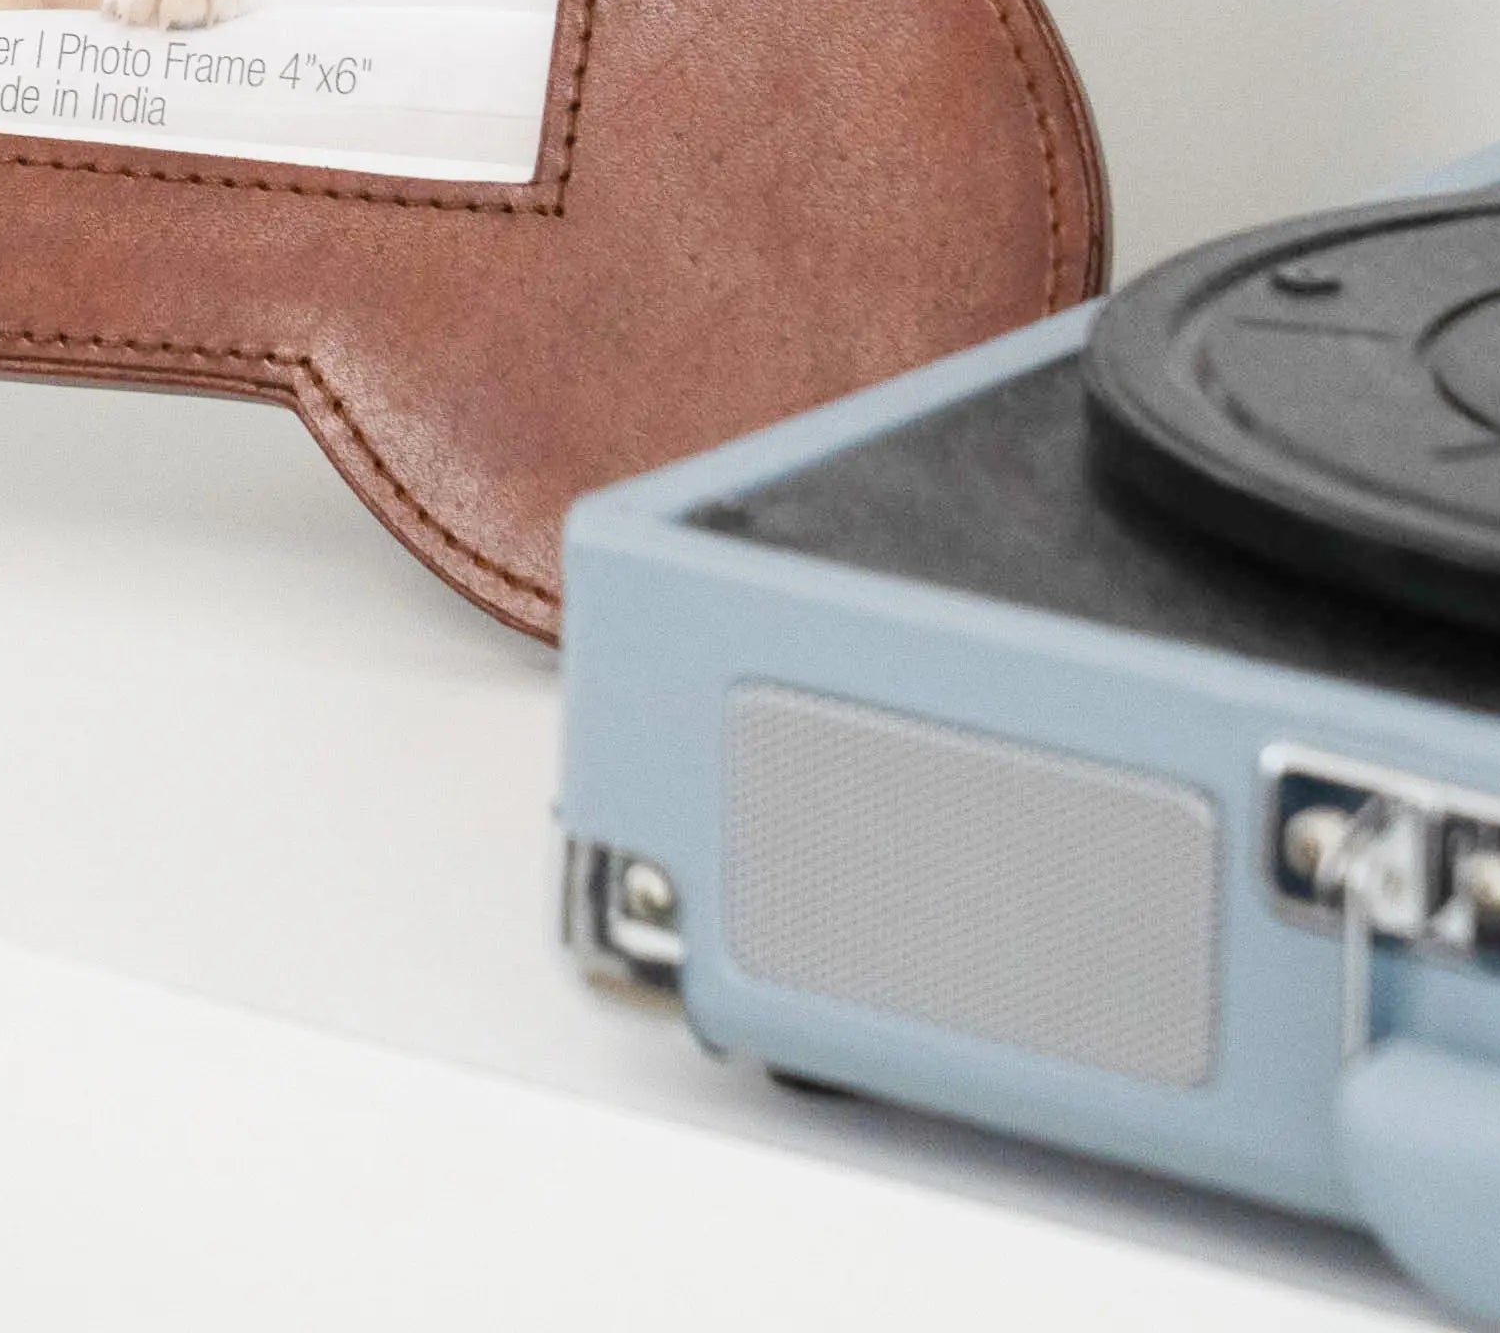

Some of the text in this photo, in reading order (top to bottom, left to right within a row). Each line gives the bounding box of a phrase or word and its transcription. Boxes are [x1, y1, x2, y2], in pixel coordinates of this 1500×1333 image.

[56, 32, 152, 78] Photo
[164, 41, 267, 88] Frame
[52, 79, 79, 120] in
[91, 82, 167, 127] India
